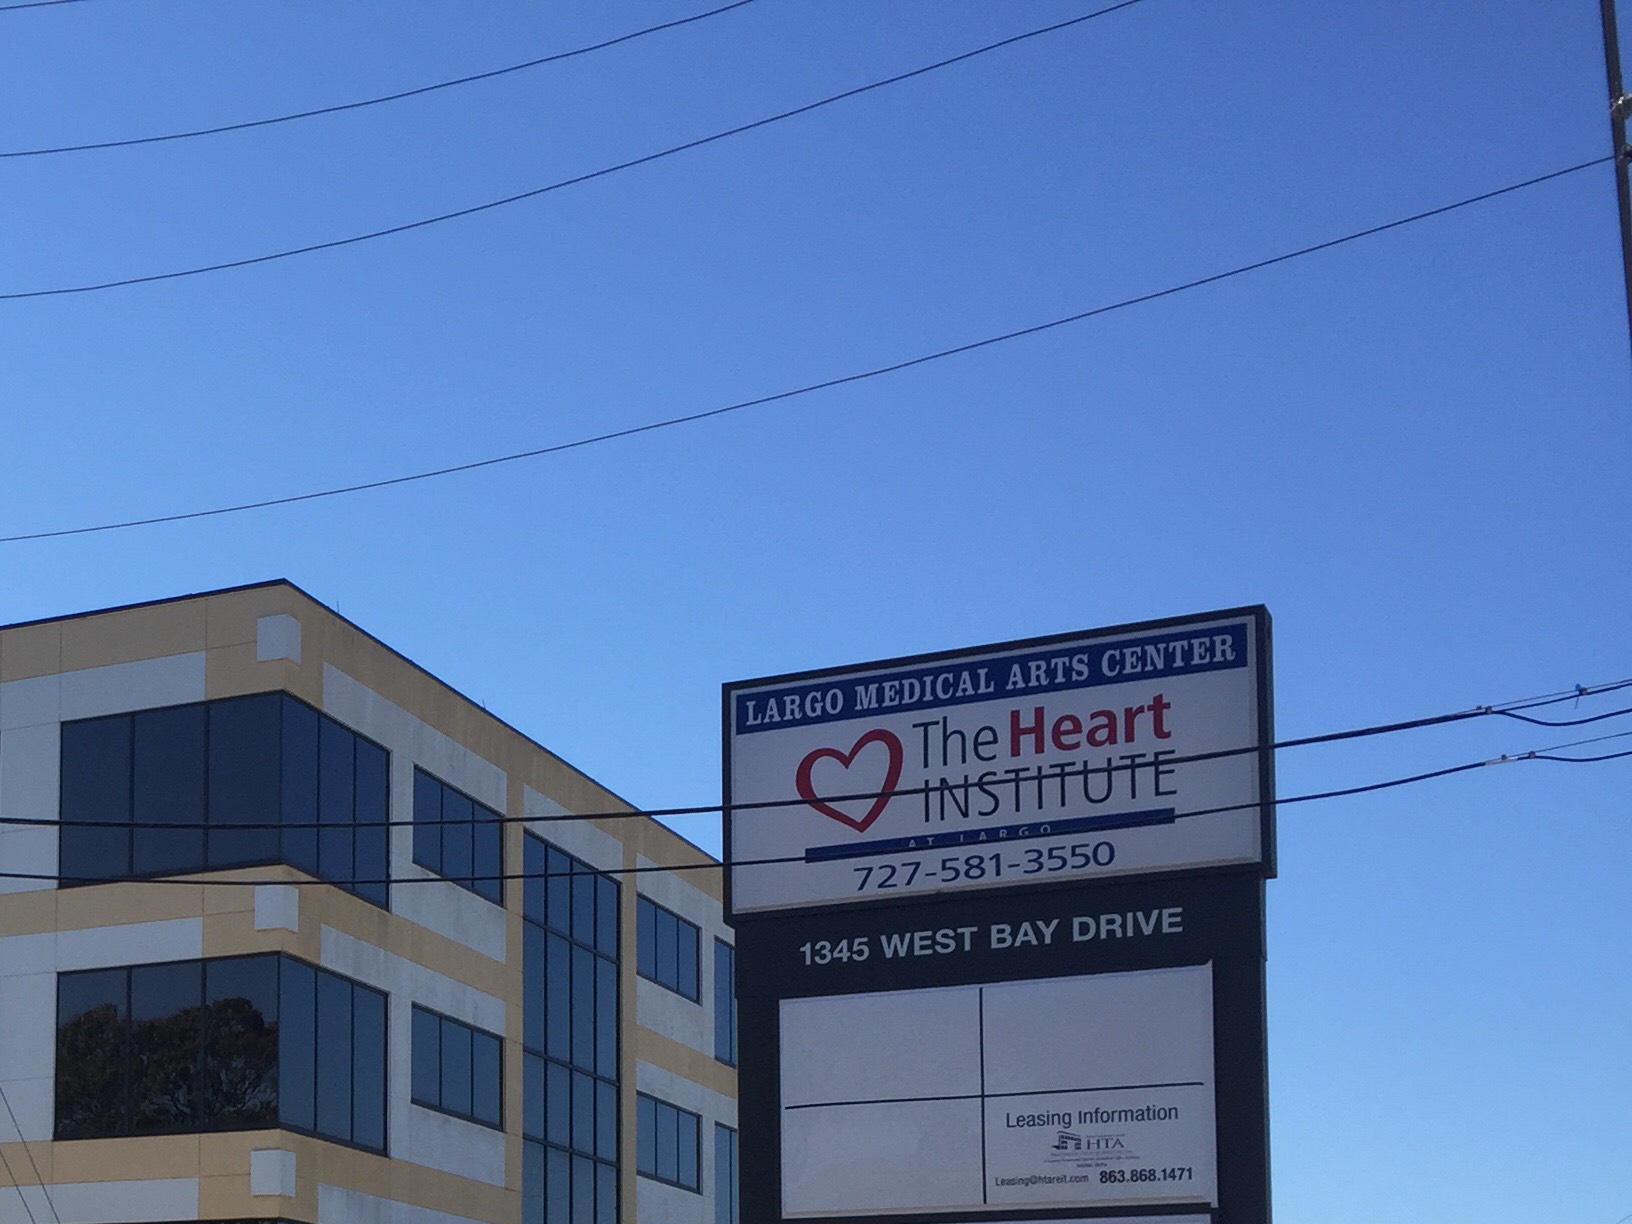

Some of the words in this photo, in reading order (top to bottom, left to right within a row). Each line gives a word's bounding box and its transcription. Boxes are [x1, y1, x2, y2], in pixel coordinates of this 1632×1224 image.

[745, 687, 845, 727] LARGO
[854, 666, 995, 710] MEDICAL
[1005, 652, 1090, 691] ARTS
[1100, 633, 1237, 678] CENTER
[912, 716, 999, 769] The
[1009, 692, 1172, 758] Heart
[922, 749, 1178, 823] INSTITUTE
[853, 840, 1116, 892] 727-581-3550
[908, 836, 935, 848] AT
[799, 936, 870, 967] 1345
[879, 926, 979, 960] WEST
[989, 918, 1060, 950] BAY
[1071, 907, 1184, 943] DRIVE
[1005, 1109, 1073, 1130] Leasing
[1077, 1104, 1179, 1127] Information
[1086, 1136, 1125, 1151] HTA
[1099, 1167, 1194, 1184] 863.868.1471
